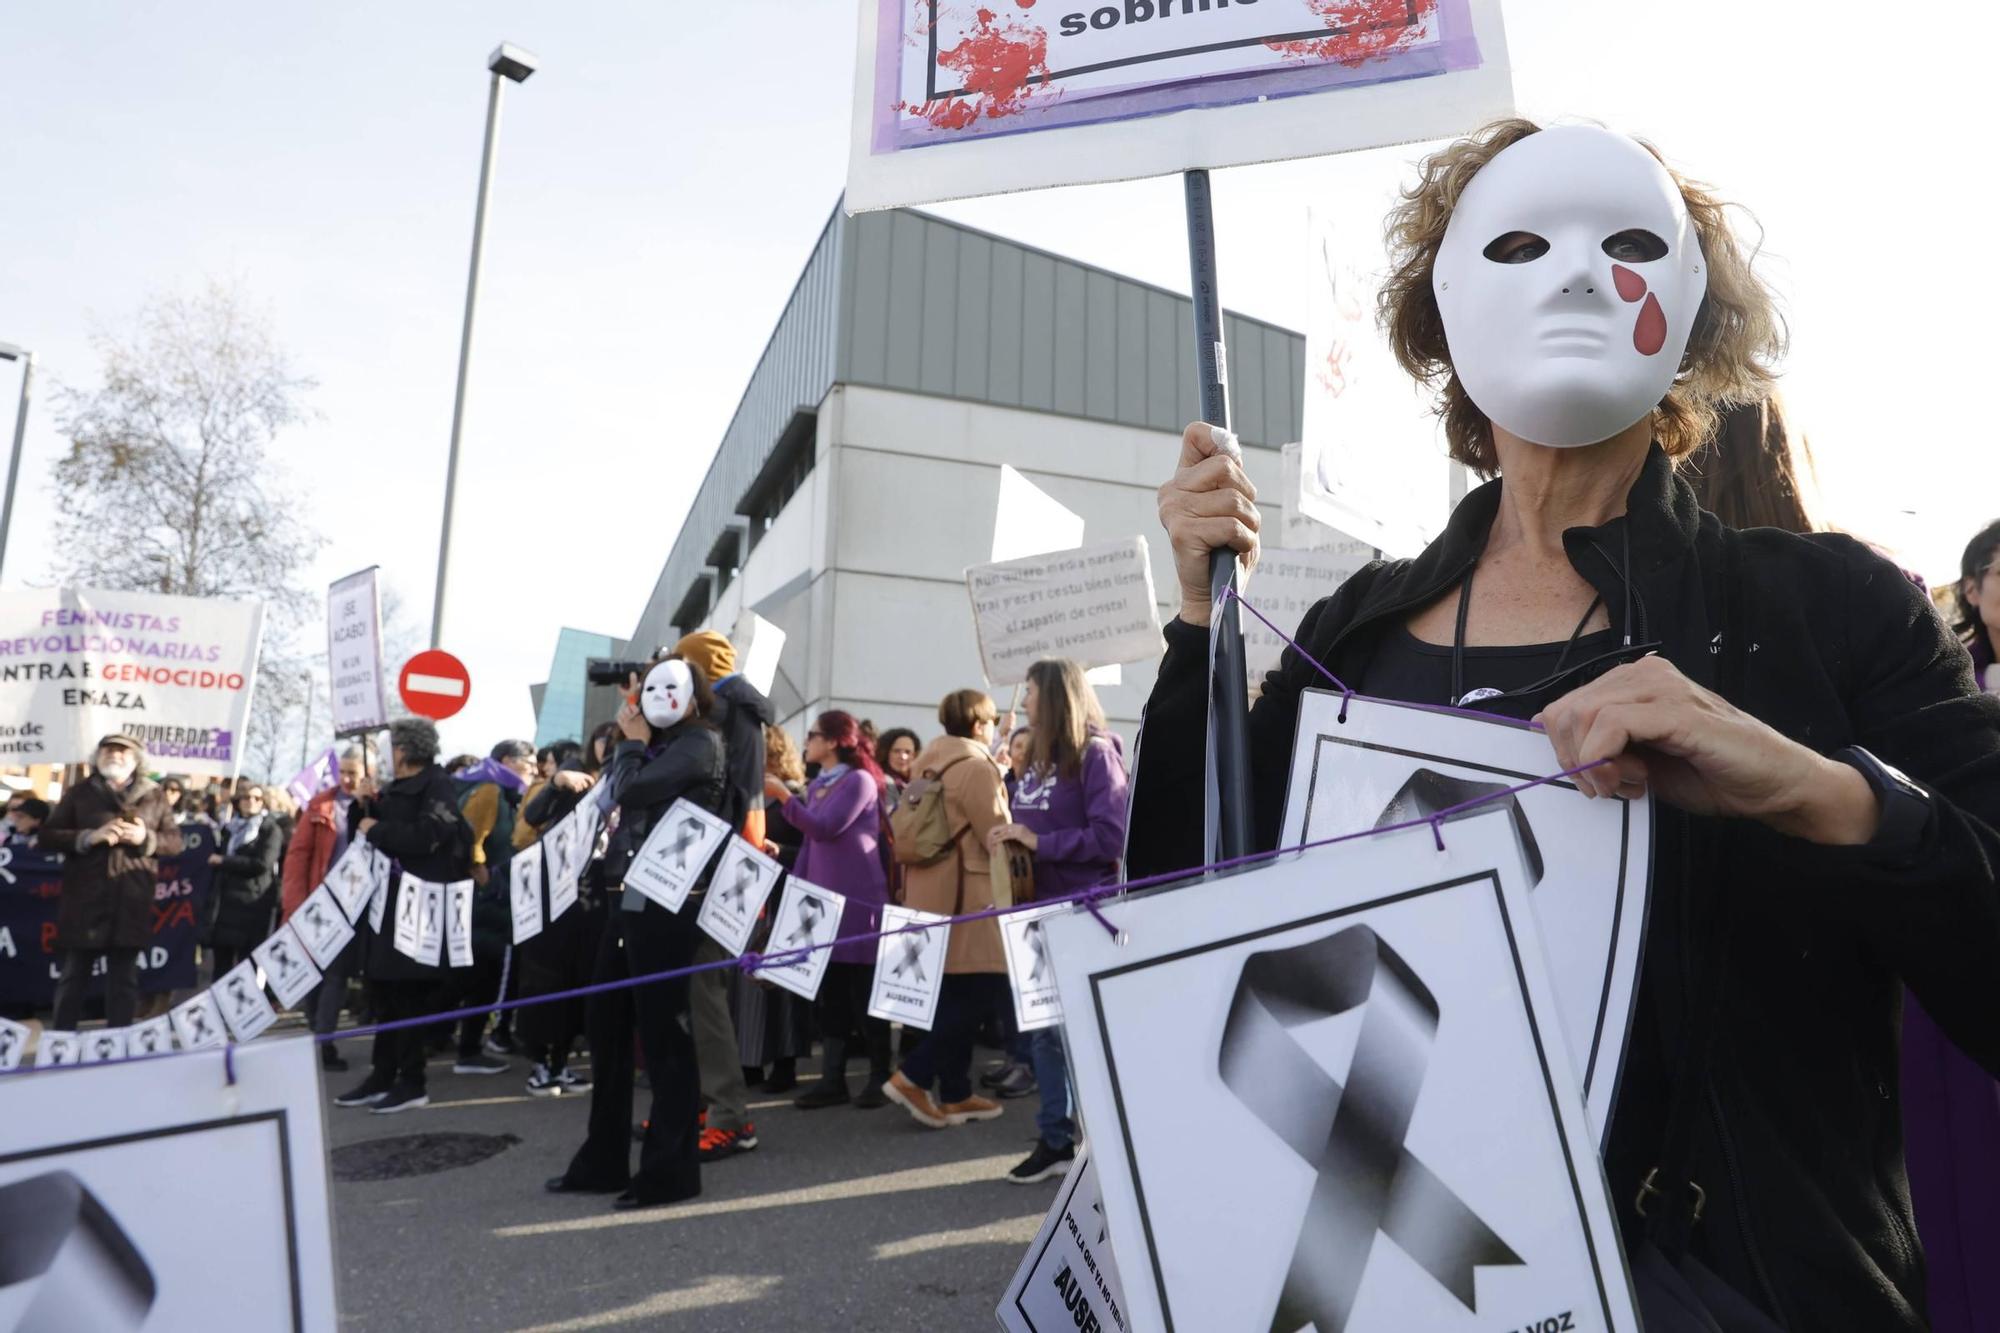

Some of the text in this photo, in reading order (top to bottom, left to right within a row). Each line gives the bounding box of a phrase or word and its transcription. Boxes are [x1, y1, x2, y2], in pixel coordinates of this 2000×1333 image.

[0, 661, 75, 682] NTRA
[101, 664, 244, 690] GENOCIDIO
[20, 722, 43, 736] de
[1065, 1212, 1078, 1238] POR
[1076, 1233, 1085, 1252] LA
[1083, 1249, 1096, 1274] QUE
[1095, 1270, 1104, 1289] YA
[1101, 1284, 1111, 1303] NO
